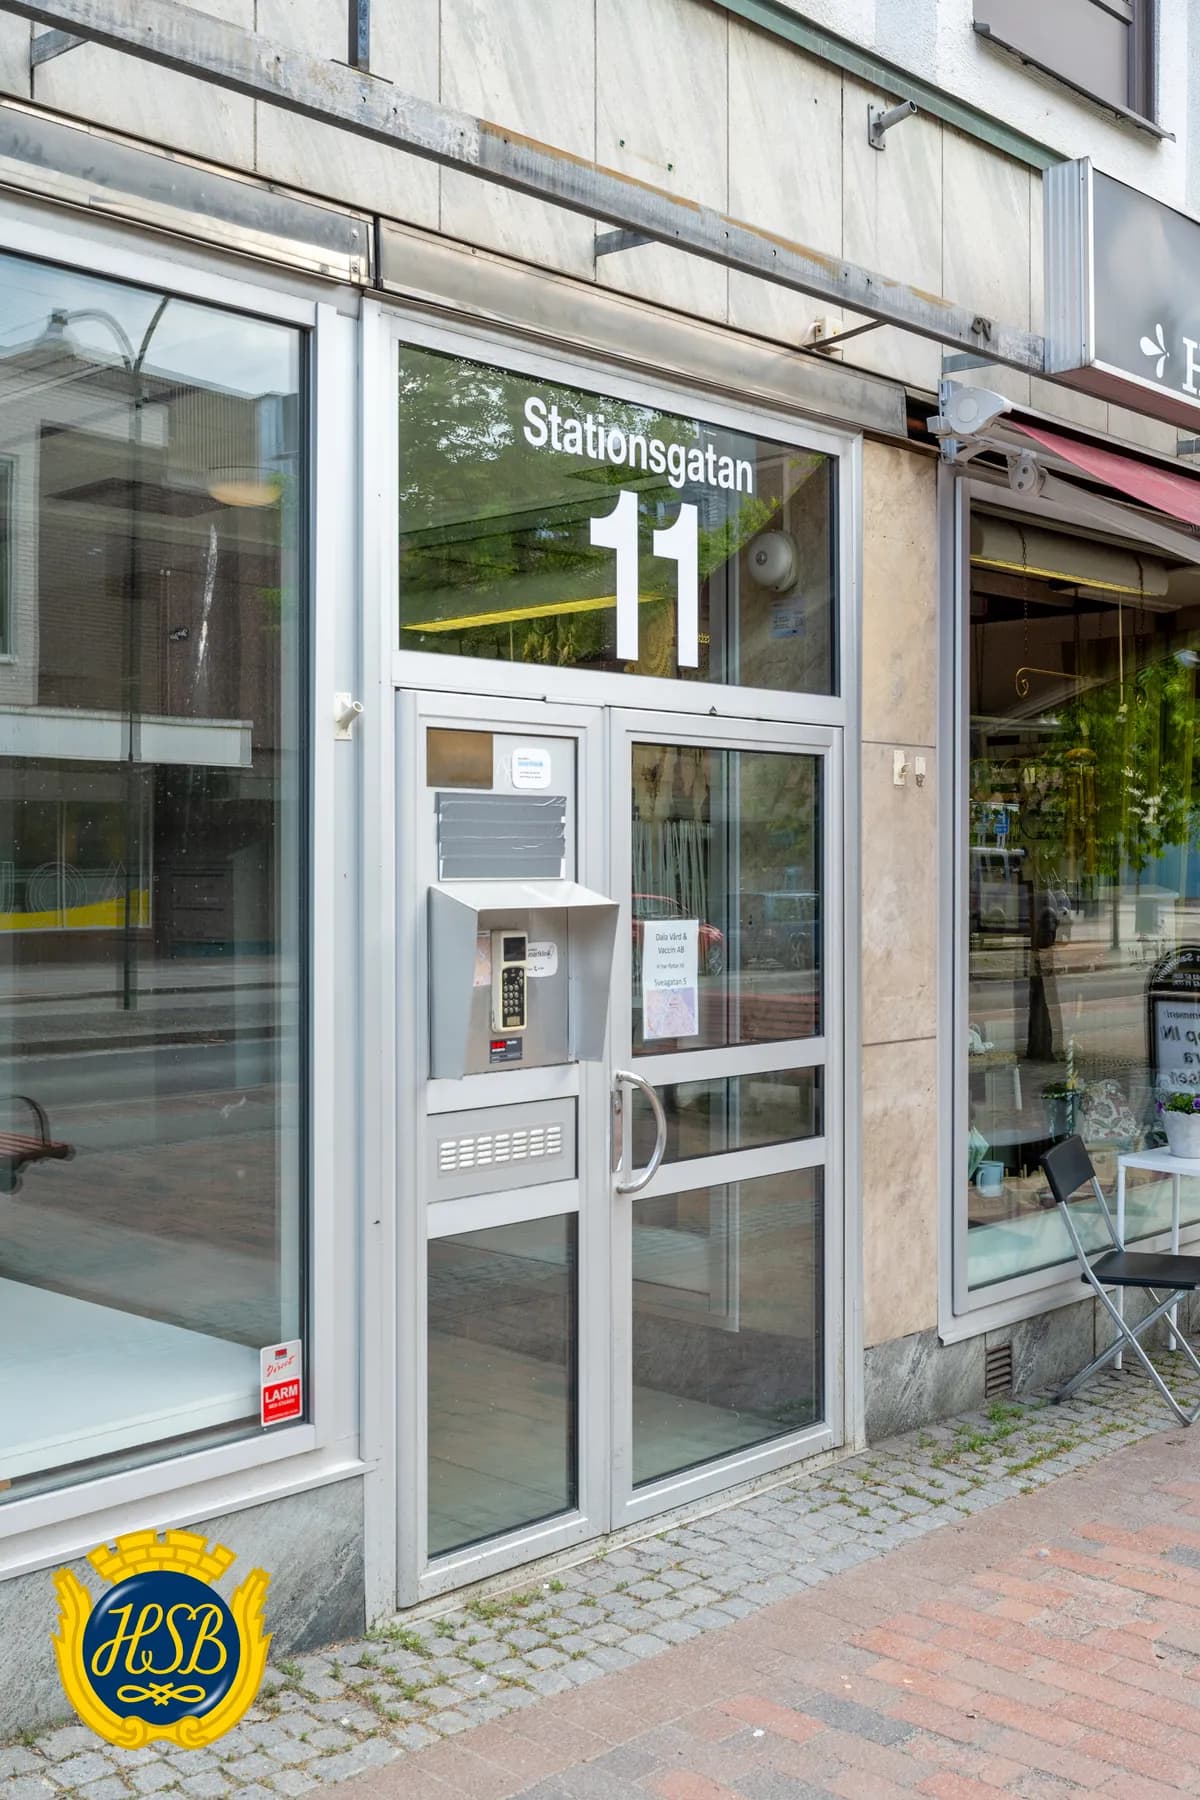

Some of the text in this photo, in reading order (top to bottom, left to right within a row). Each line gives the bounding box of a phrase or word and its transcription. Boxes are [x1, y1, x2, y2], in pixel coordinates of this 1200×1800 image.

[523, 396, 753, 494] Stationsgatan
[590, 490, 699, 668] 11
[658, 945, 685, 954] Vaccin AB
[265, 1384, 298, 1403] LARM
